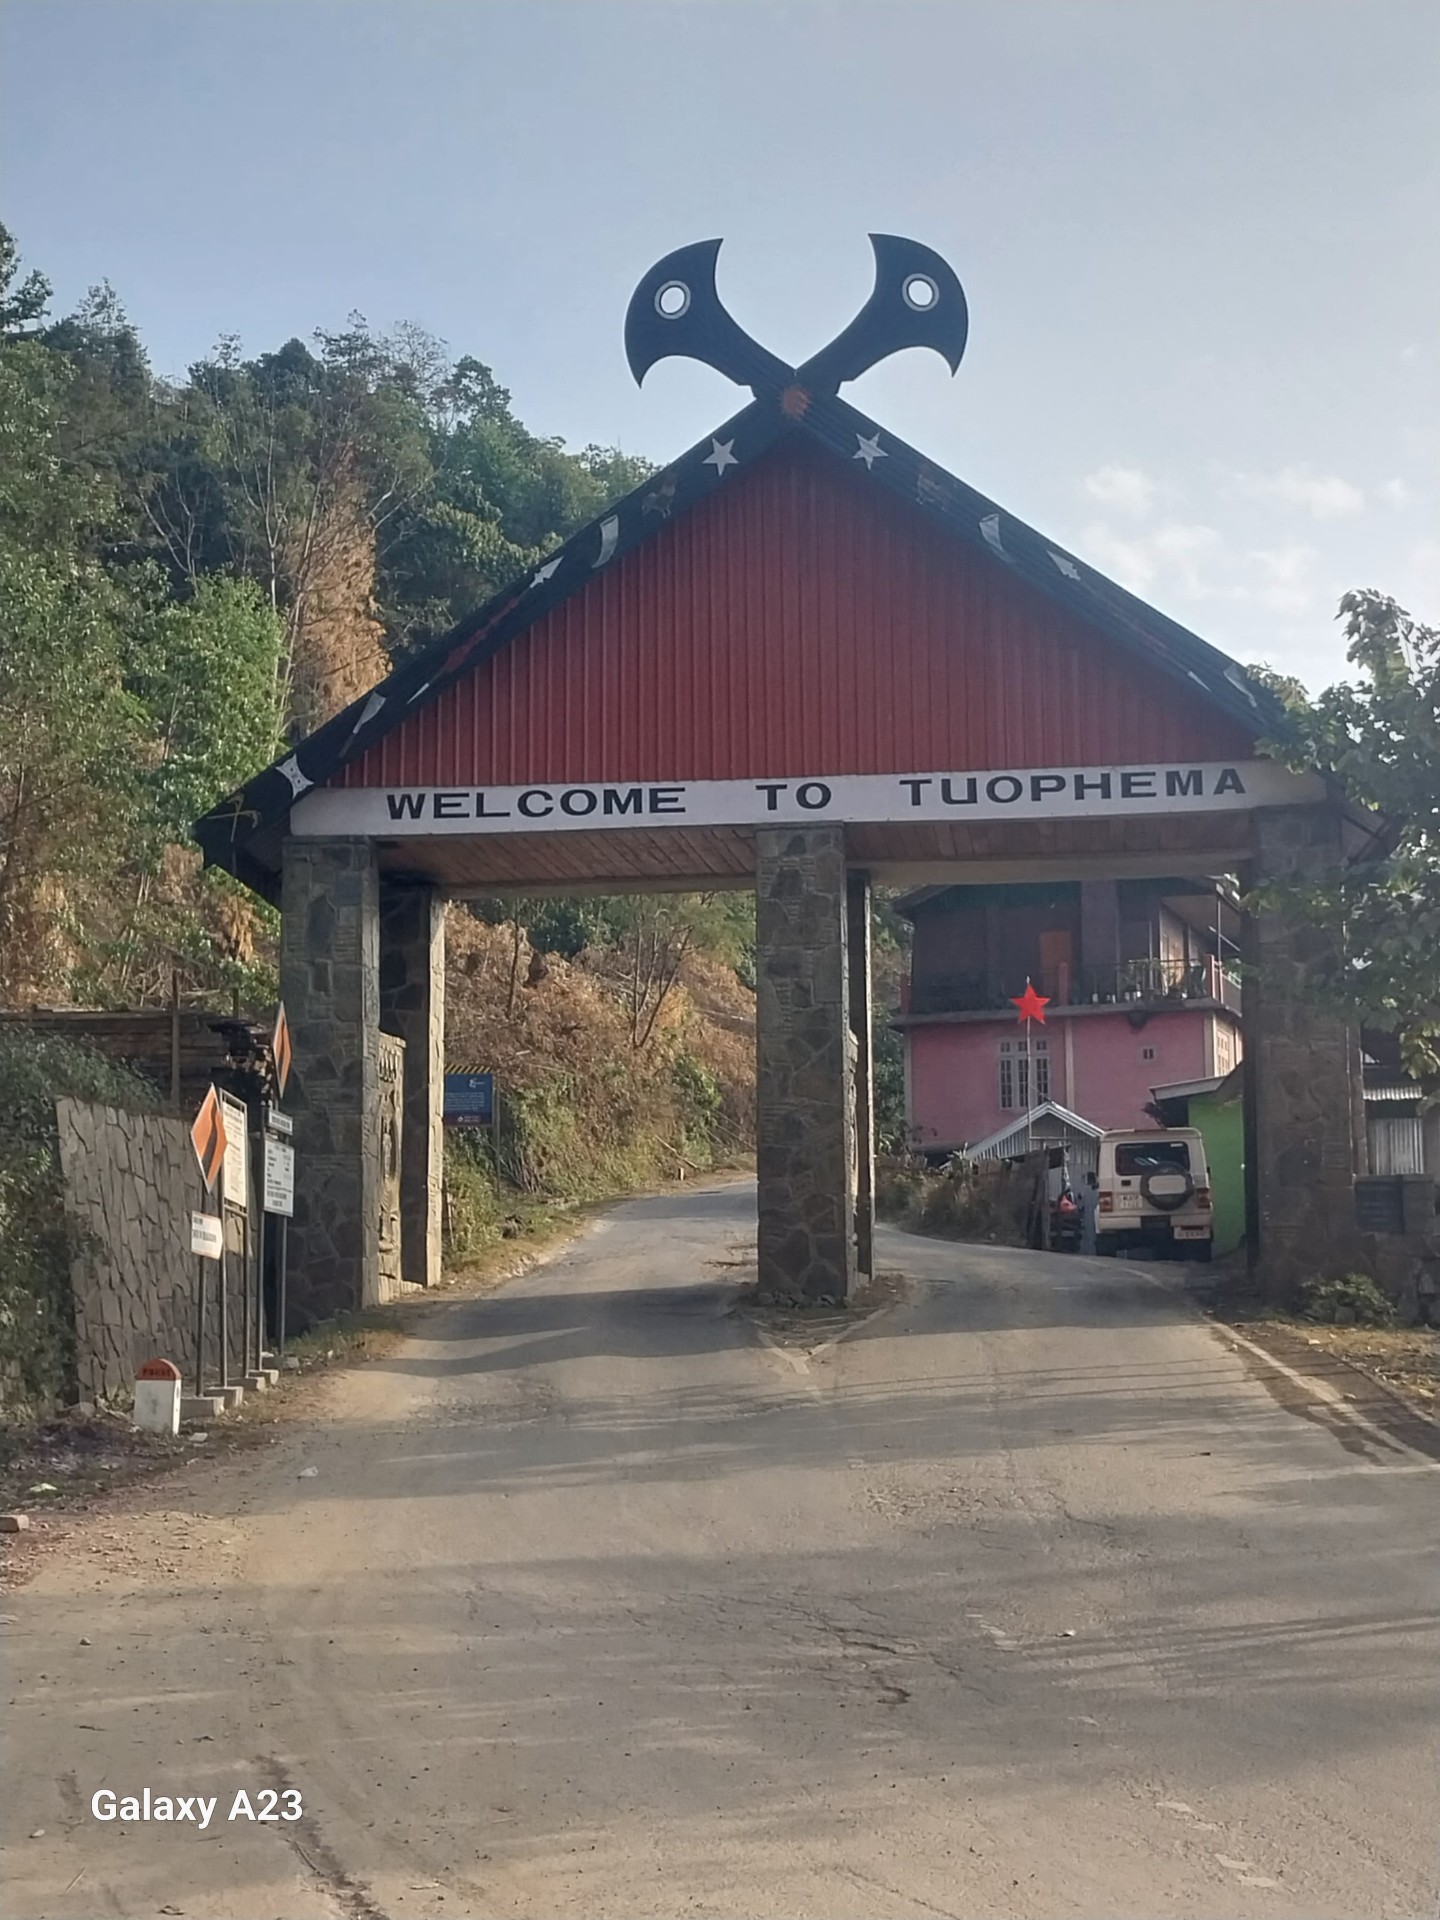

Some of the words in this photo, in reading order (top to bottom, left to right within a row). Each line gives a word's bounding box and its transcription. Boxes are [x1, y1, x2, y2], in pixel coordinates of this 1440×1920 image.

[386, 786, 687, 820] WELCOME
[755, 782, 832, 811] TO
[899, 768, 1247, 807] TUOPHEMA
